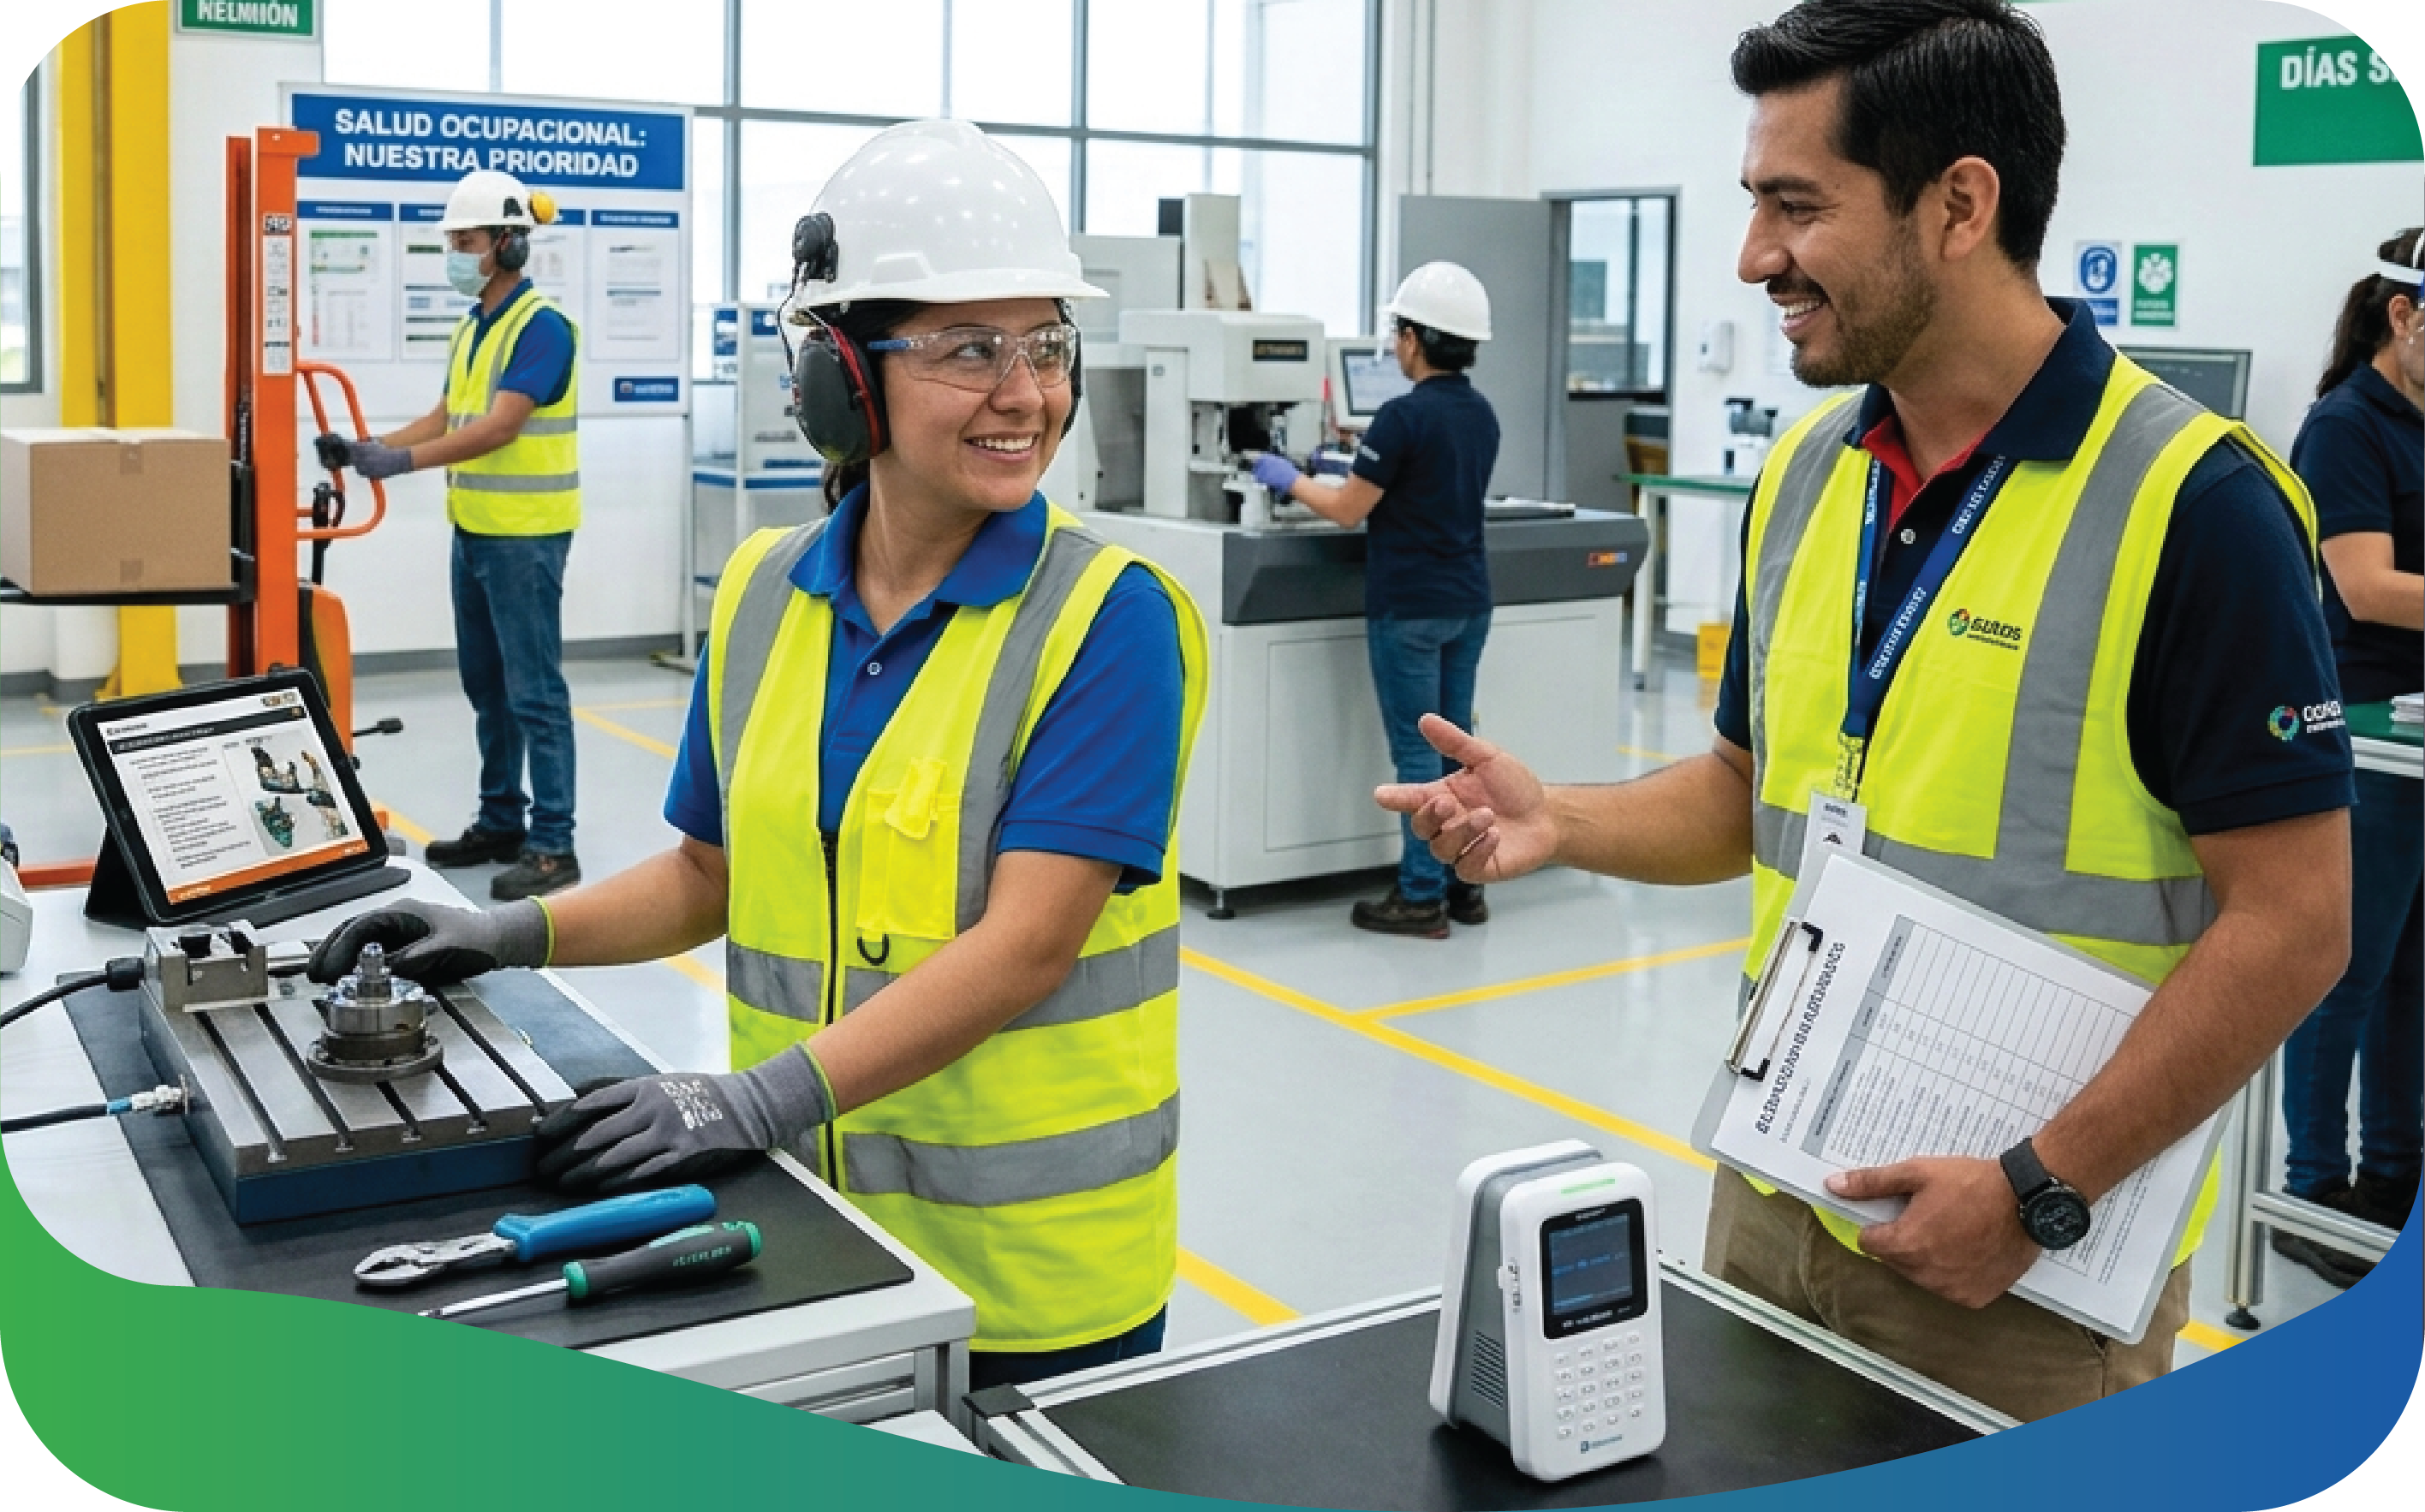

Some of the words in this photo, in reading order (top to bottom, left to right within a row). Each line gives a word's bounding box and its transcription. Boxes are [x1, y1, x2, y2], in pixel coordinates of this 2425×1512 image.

[2279, 45, 2357, 90] DÍAS
[2367, 50, 2398, 84] S
[335, 108, 432, 137] SALUD
[439, 113, 647, 147] OCUPACIONAL:
[344, 142, 480, 170] NUESTRA
[488, 148, 639, 177] PRIORIDAD
